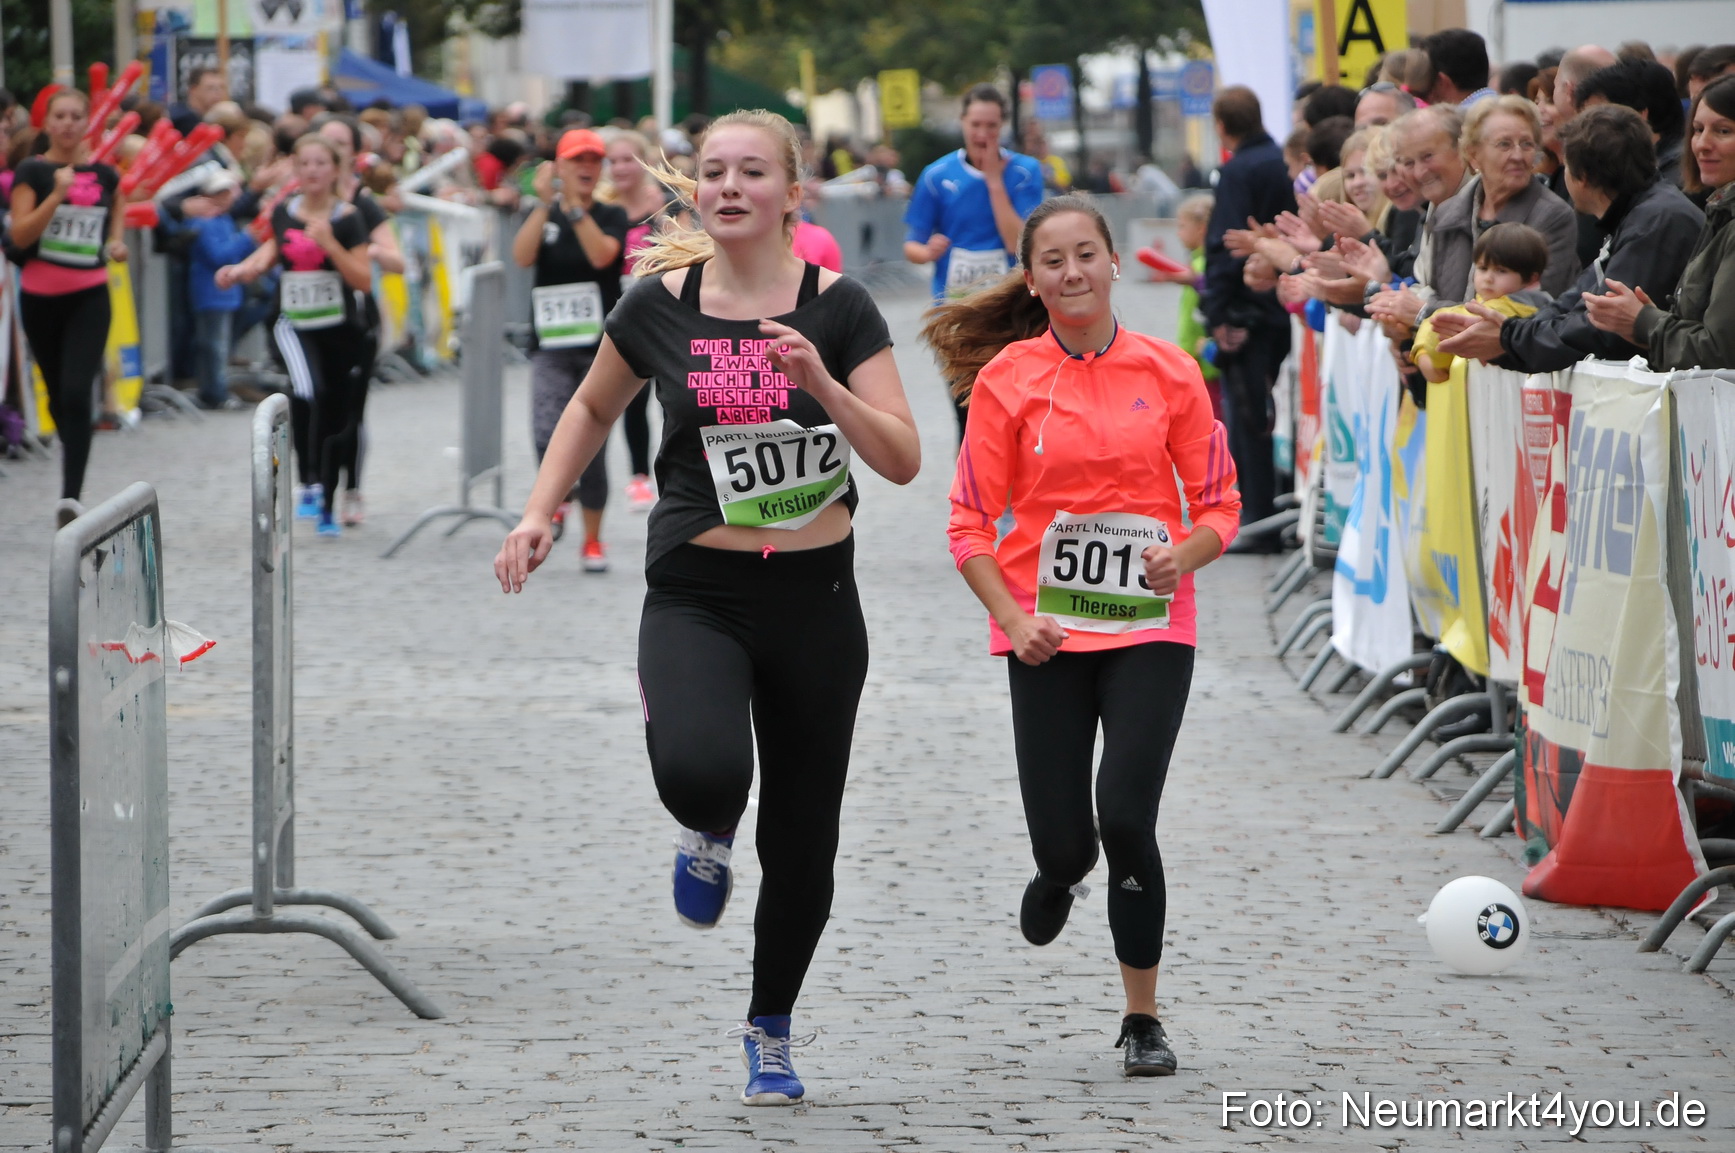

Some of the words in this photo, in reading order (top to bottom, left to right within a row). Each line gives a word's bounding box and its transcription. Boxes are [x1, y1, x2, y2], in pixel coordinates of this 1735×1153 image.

[692, 341, 730, 354] WIR
[713, 357, 771, 369] ZWAR
[689, 374, 750, 388] NICHT
[719, 409, 771, 423] ABER
[705, 432, 752, 447] PARTL
[724, 433, 842, 493] 5072
[758, 489, 827, 520] Kristina
[1049, 521, 1091, 533] PARTL
[1093, 522, 1154, 540] Neumarkt
[1069, 594, 1138, 618] Theresa
[1478, 904, 1498, 940] BMW
